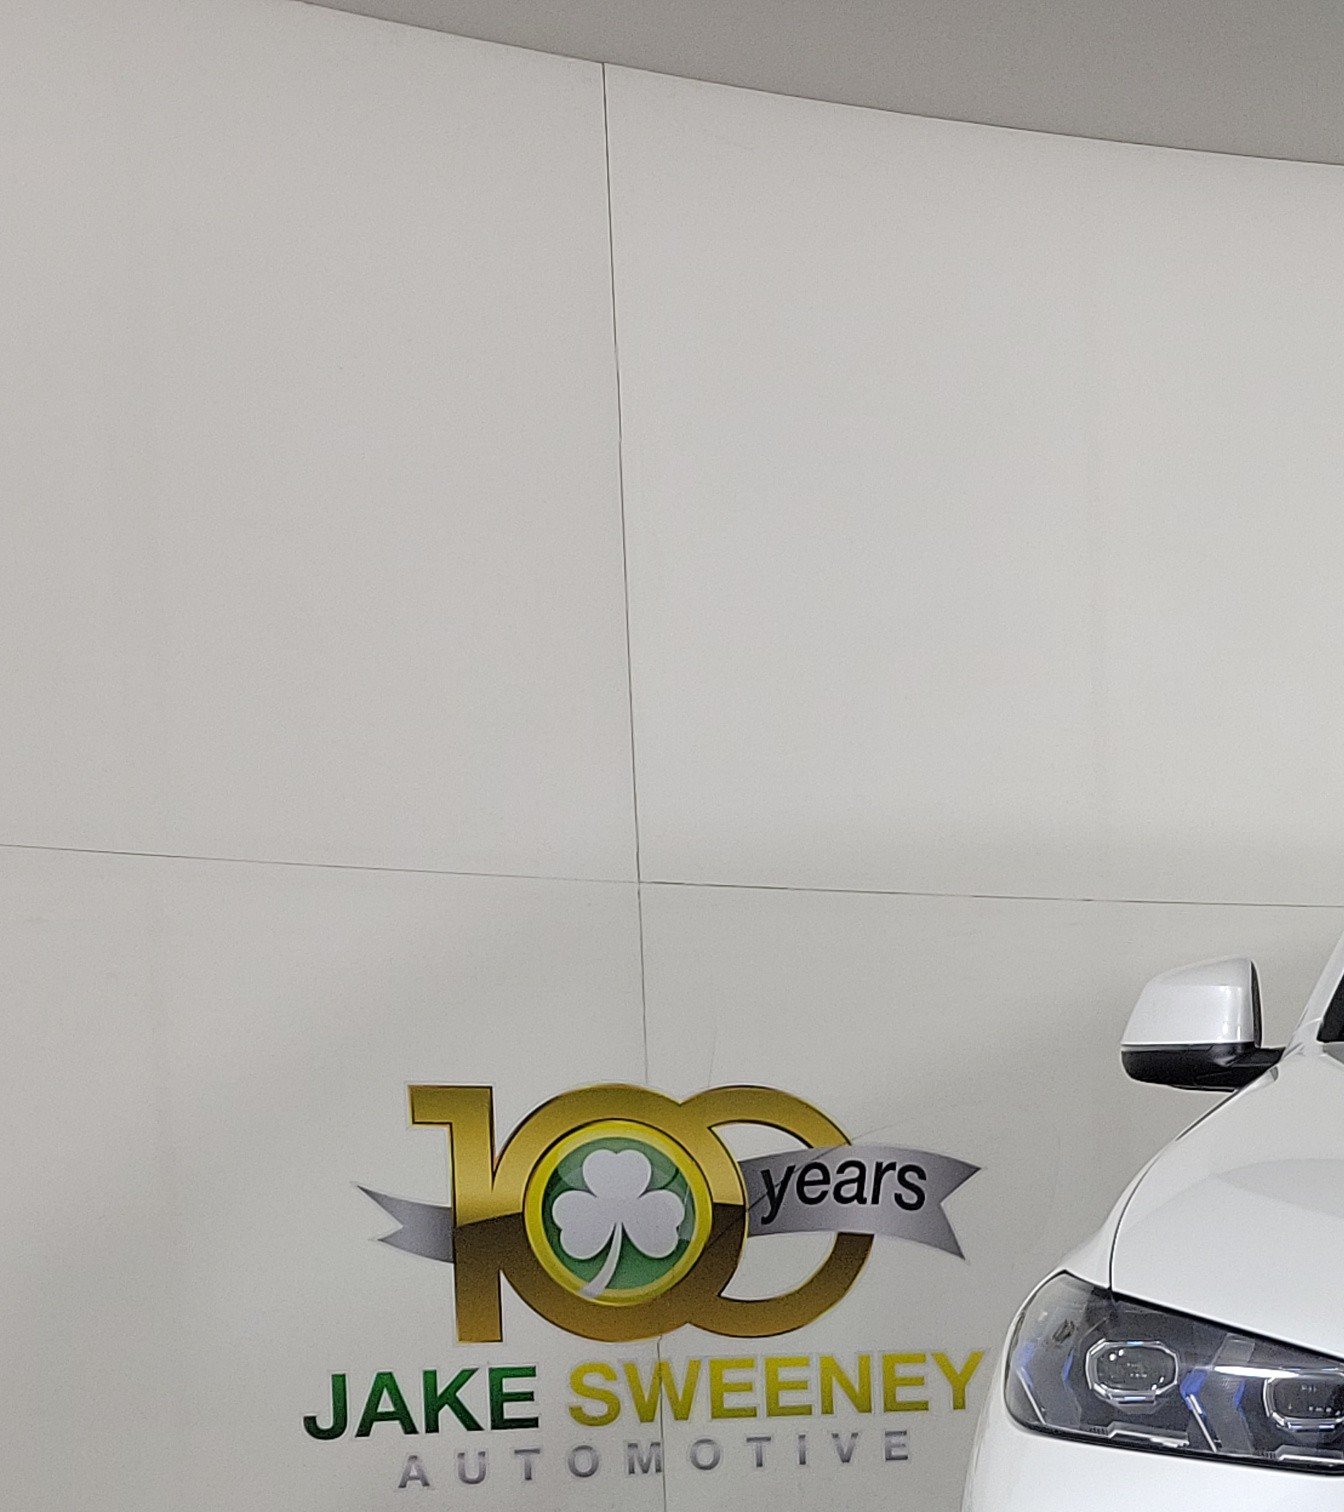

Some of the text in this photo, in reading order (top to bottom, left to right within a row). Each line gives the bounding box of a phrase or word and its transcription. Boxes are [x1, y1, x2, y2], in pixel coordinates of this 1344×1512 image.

[409, 1084, 927, 1342] 100 years
[304, 1351, 984, 1440] JAKE SWEENEY
[399, 1431, 909, 1489] AUTOMOTIVE
